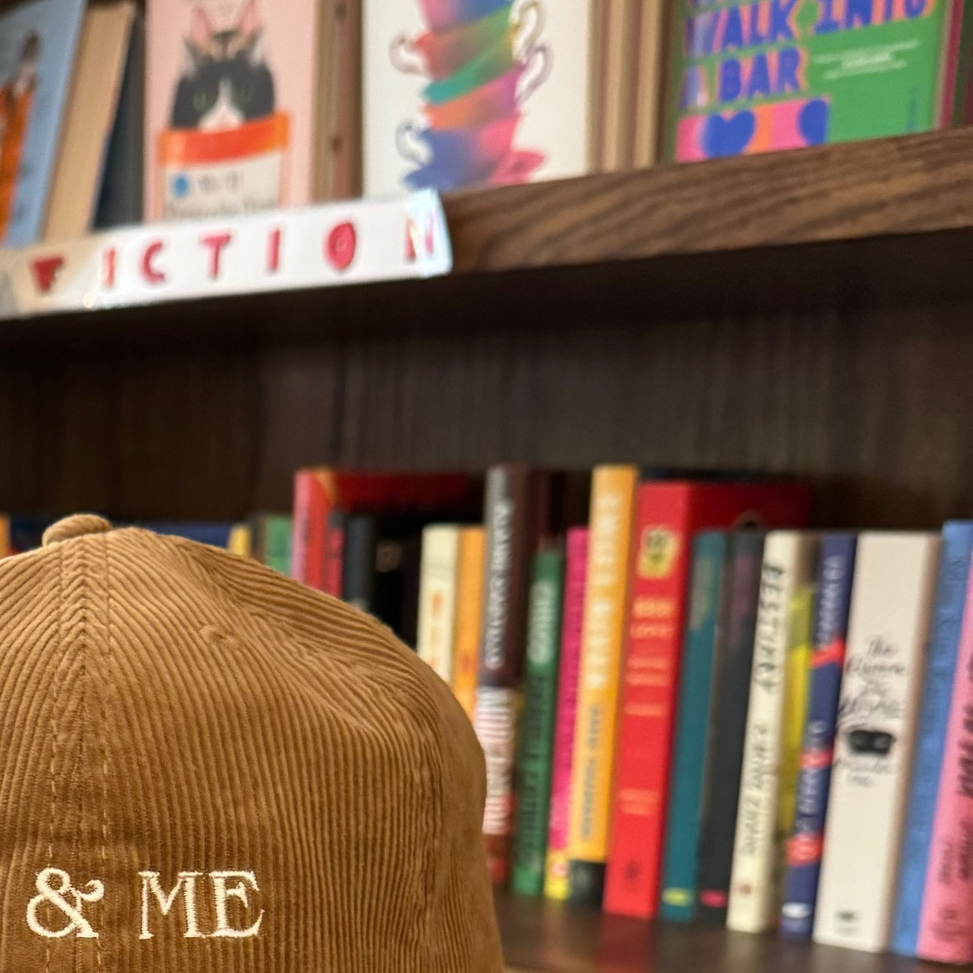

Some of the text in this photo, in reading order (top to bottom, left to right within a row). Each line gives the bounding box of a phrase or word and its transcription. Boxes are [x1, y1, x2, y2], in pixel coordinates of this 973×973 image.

[684, 0, 799, 57] WALK
[719, 47, 808, 104] BAR
[26, 867, 105, 938] &
[138, 870, 265, 940] ME
